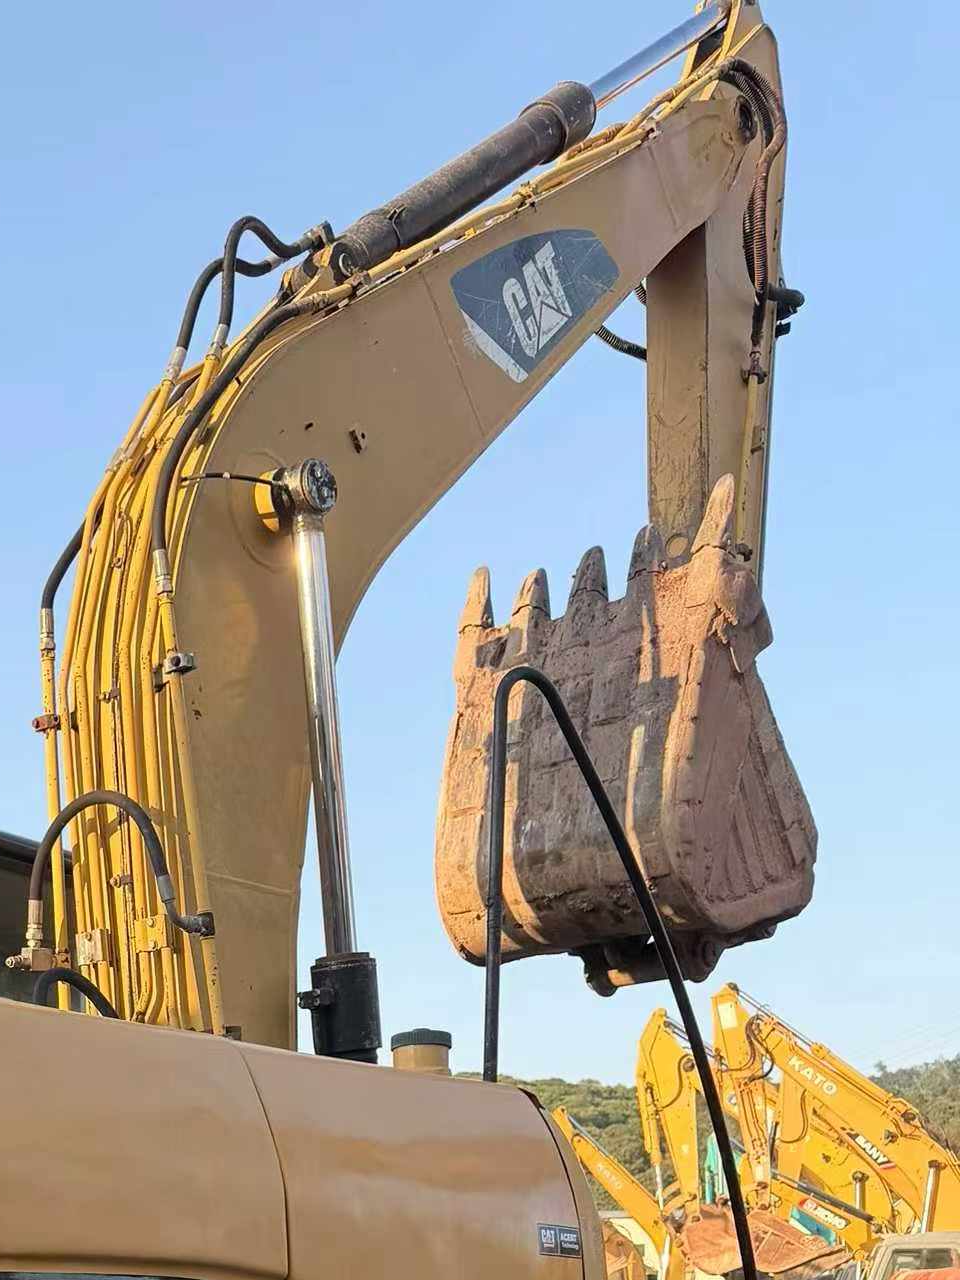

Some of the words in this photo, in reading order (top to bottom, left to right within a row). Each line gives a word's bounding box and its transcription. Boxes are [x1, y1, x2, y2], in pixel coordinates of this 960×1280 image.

[502, 241, 572, 358] CAT
[788, 1055, 837, 1096] KATO
[541, 1228, 555, 1248] CAT
